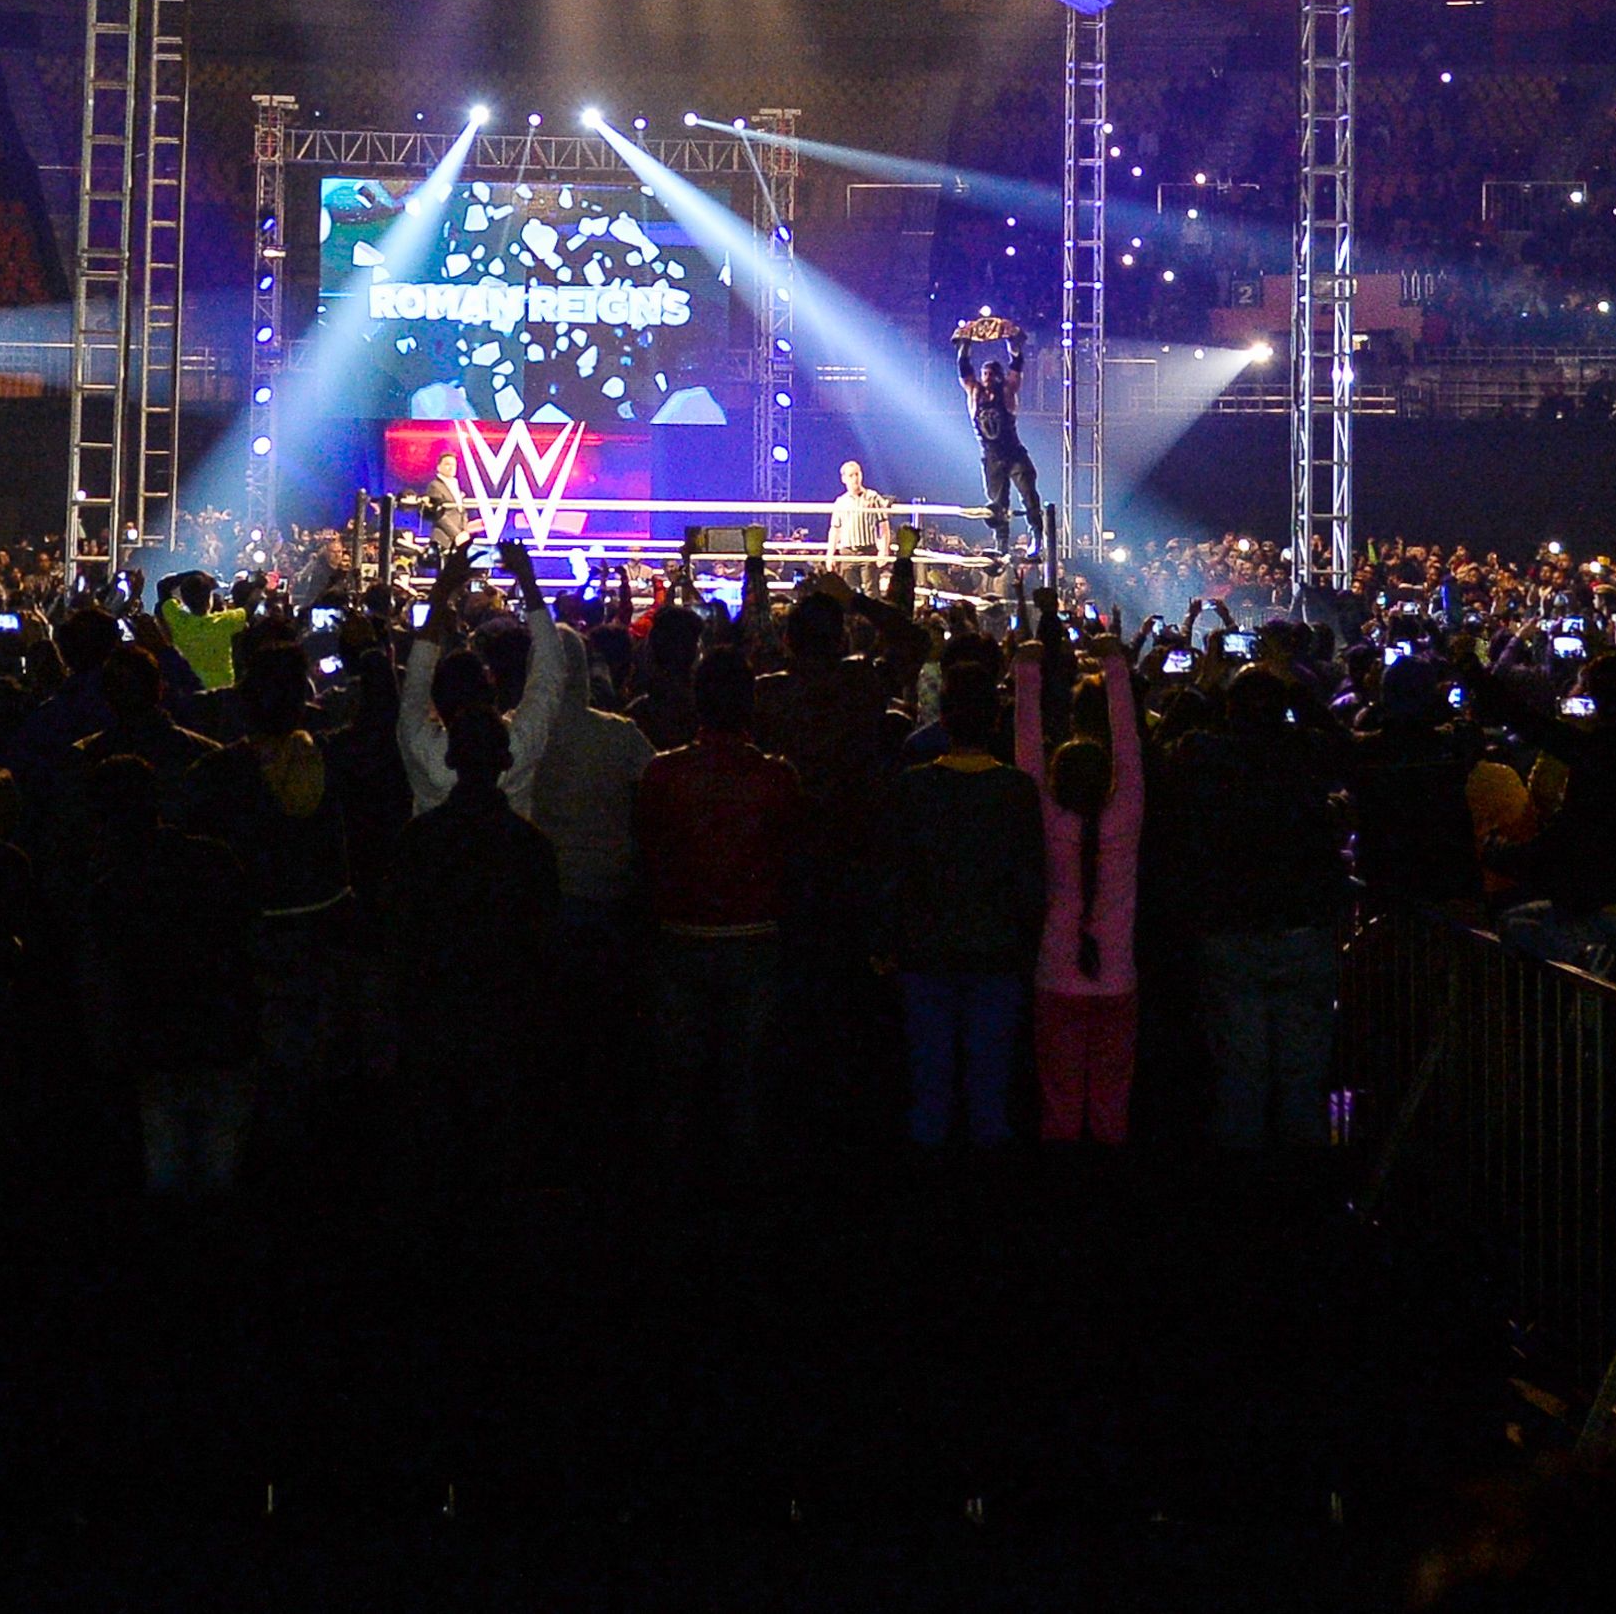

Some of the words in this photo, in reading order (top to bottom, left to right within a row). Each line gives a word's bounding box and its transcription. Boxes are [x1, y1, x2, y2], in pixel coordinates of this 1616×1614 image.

[369, 284, 525, 324] ROMAN
[528, 286, 690, 325] REIGNS
[1238, 285, 1253, 303] 2
